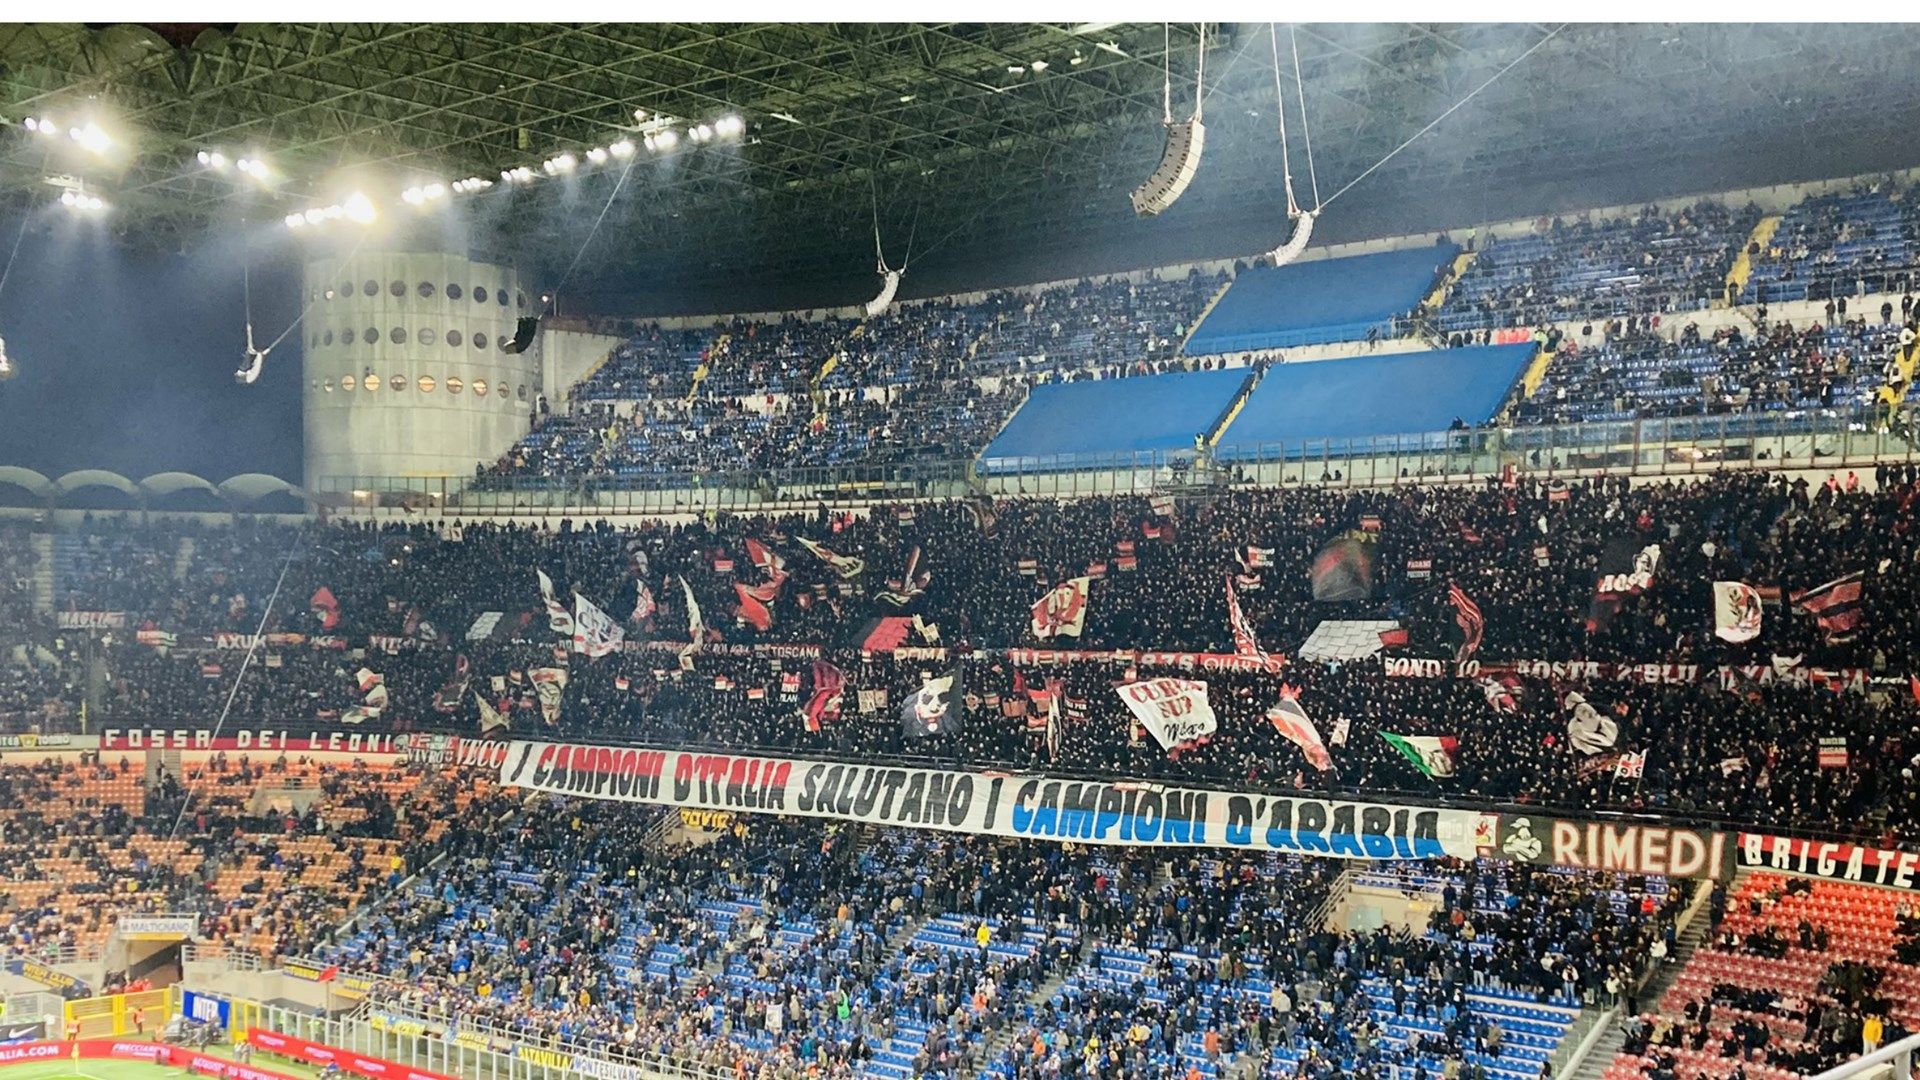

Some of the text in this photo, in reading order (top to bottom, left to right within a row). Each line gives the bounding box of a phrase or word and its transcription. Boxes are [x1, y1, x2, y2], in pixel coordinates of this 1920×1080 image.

[771, 646, 820, 658] TOSCANA
[105, 729, 210, 748] FOSSA
[237, 730, 287, 748] DEI
[310, 731, 391, 751] LEONI
[510, 743, 1446, 859] I CAMPIONI D'ITALIA SALUTANO I CAMPIONI D'ARABIA
[1552, 820, 1726, 880] RIMEDI
[1744, 833, 1920, 889] BRIGATE
[518, 1047, 571, 1069] ALTAVILLA
